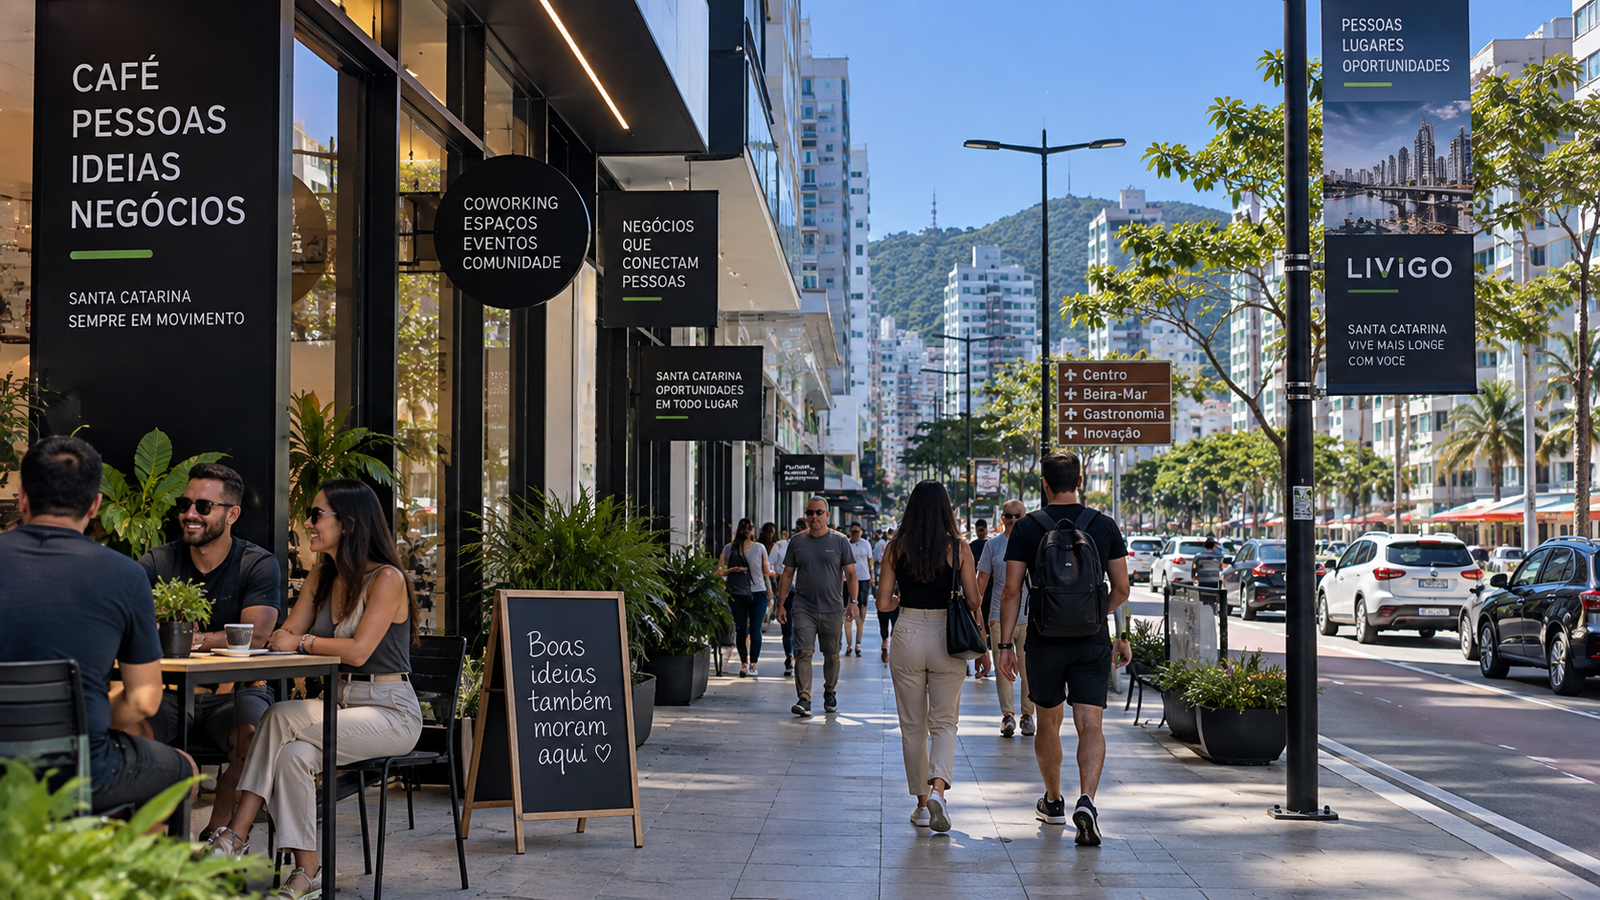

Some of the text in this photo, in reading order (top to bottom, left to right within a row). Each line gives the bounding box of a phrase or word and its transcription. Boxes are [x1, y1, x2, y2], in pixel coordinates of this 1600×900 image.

[1342, 18, 1402, 32] PESSOAS
[1342, 38, 1404, 52] LUGARES
[1342, 58, 1450, 73] OPORTUNIDADES
[72, 54, 160, 93] CAFÉ
[72, 104, 227, 138] PESSOAS
[71, 151, 181, 184] IDEIAS
[70, 190, 246, 229] NEGÓCIOS
[463, 195, 559, 211] COWORKING
[464, 215, 538, 234] ESPAÇOS
[622, 217, 695, 233] NEGÓCIOS
[463, 235, 538, 251] EVENTOS
[622, 238, 652, 253] QUE
[462, 255, 561, 270] COMUNIDADE
[622, 256, 699, 270] CONECTAM
[622, 274, 686, 288] PESSOAS
[69, 289, 192, 305] SANTA CATARINA
[68, 311, 245, 328] SEMPRE EM MOVIMENTO
[1348, 323, 1448, 335] SANTA CATARINA
[1348, 339, 1445, 350] VIVE MAIS LONGE
[1348, 356, 1406, 366] COM VOCE
[655, 371, 743, 381] SANTA CATARINA
[1082, 368, 1128, 382] Centro
[655, 384, 744, 395] OPORTUNIDADES
[1083, 387, 1149, 400] Beira-Mar
[655, 399, 739, 410] EM TODO LUGAR
[1082, 407, 1165, 420] Gastronomia
[1083, 426, 1141, 441] Inovação
[526, 629, 585, 658] Boas
[530, 660, 597, 684] ideias
[527, 688, 613, 712] também
[534, 719, 608, 738] moram
[538, 743, 588, 775] aqui
